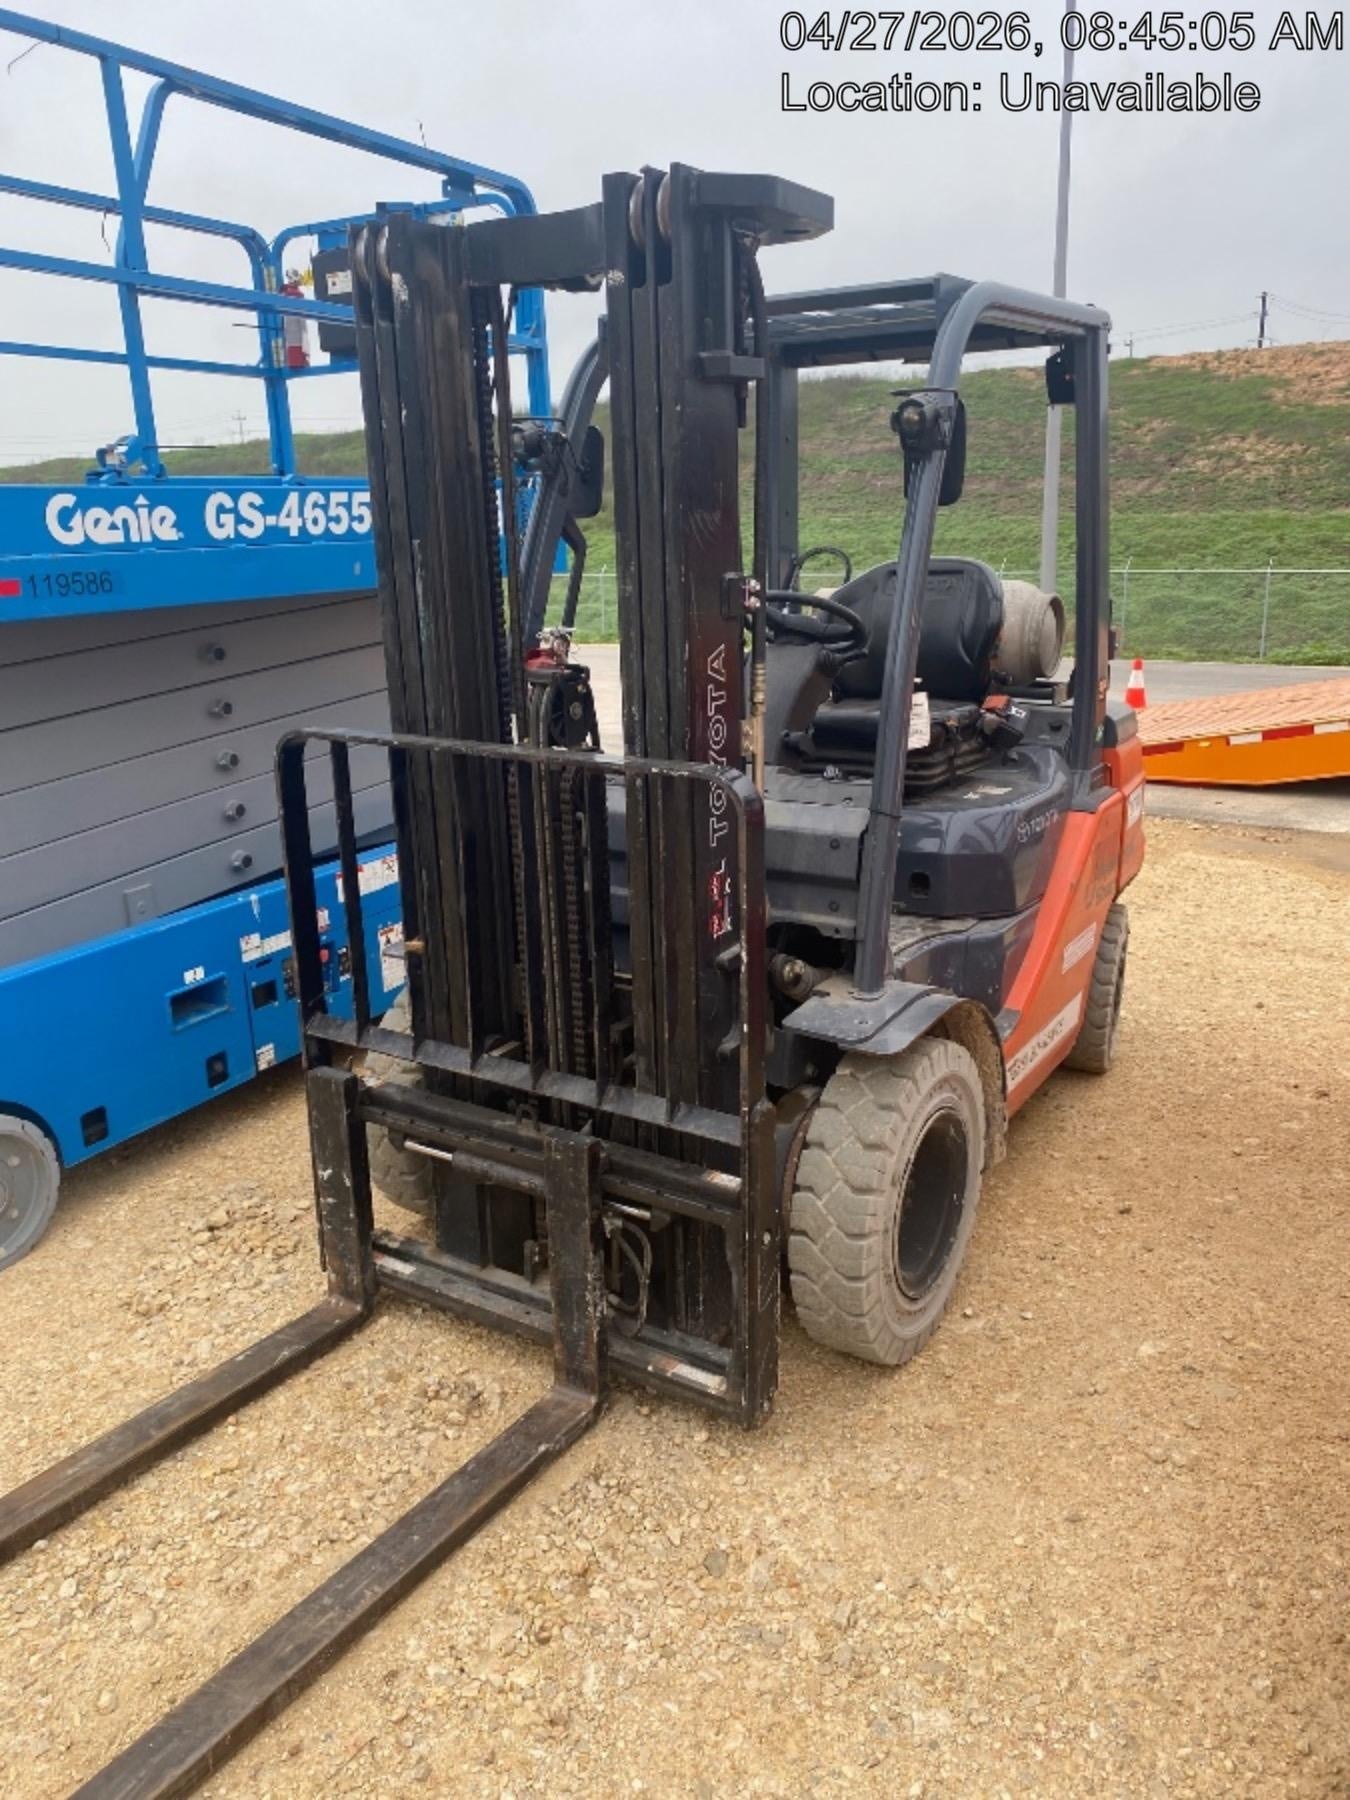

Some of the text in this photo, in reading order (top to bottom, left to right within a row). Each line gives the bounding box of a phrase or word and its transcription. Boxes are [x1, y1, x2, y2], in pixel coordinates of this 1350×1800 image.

[46, 491, 372, 545] Genie GS-4655
[28, 571, 113, 598] 119586
